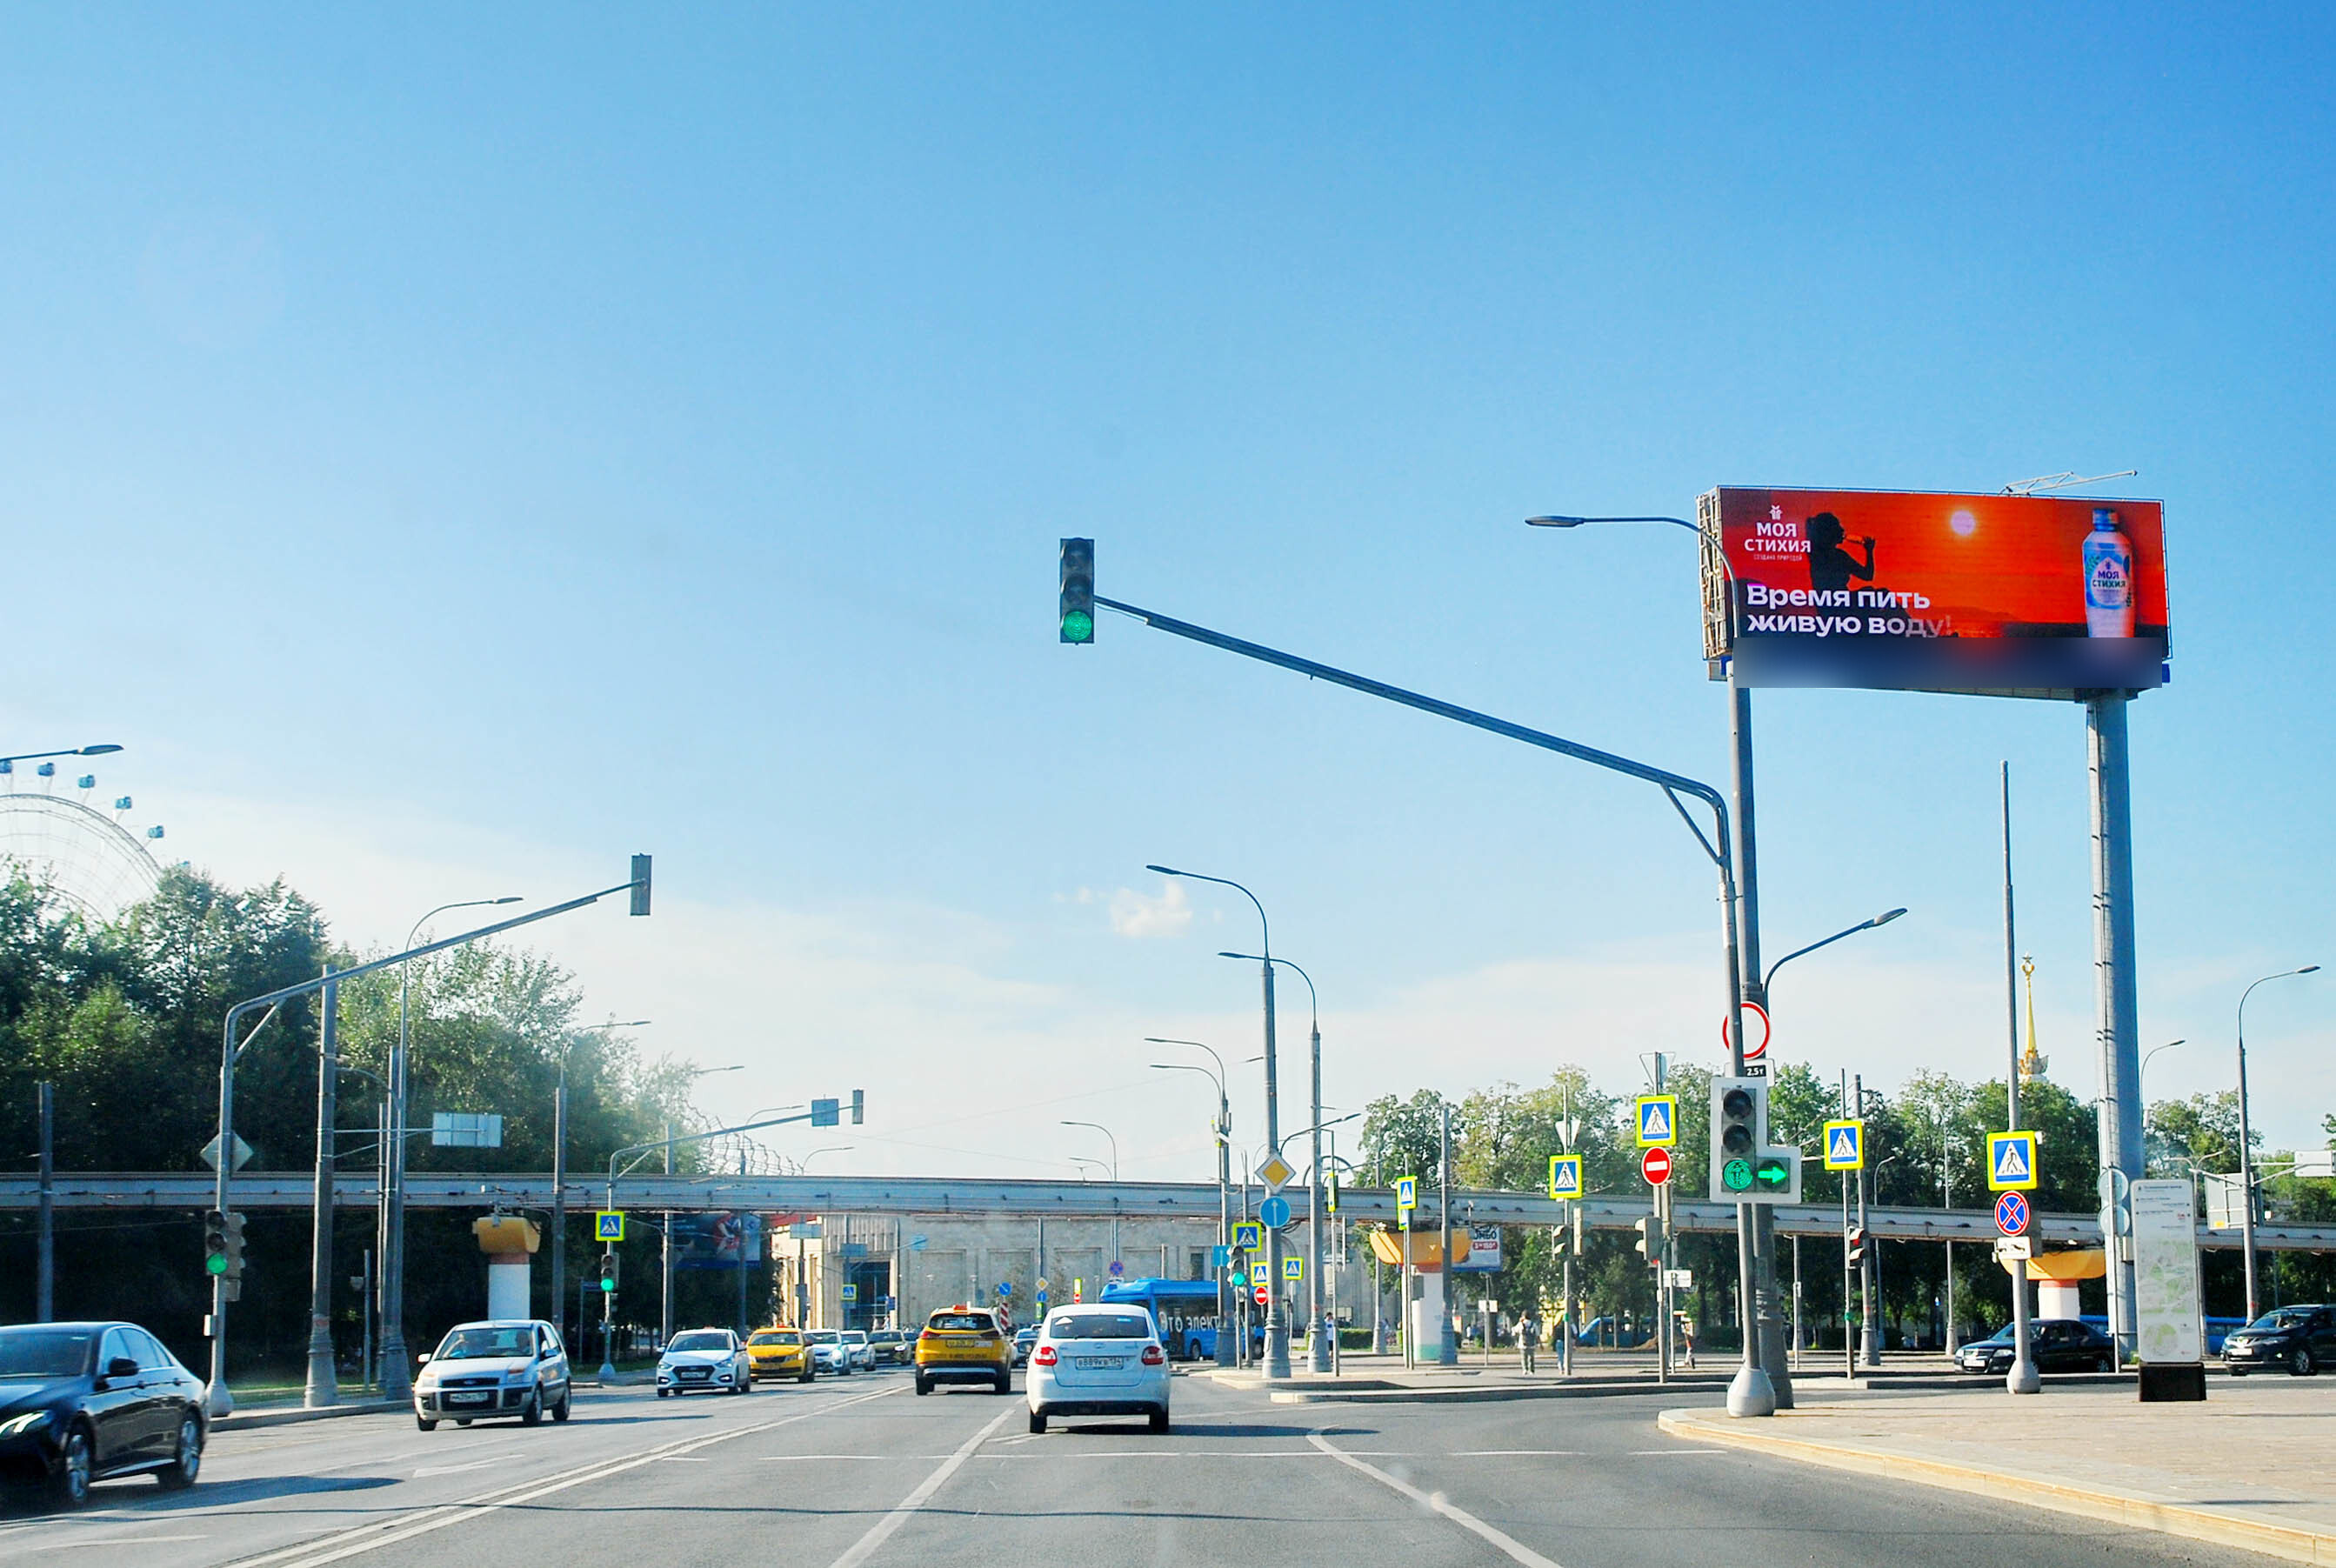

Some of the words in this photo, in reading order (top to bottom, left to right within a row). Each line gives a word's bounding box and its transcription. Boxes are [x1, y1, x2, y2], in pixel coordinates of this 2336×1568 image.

[1757, 522, 1797, 537] МОЯ
[1744, 539, 1811, 553] СТИХИЯ
[2098, 570, 2119, 579] МОЯ
[1746, 584, 1850, 610] Время
[1858, 591, 1931, 609] пить
[1747, 614, 1862, 637] живую
[1158, 1311, 1183, 1333] Это
